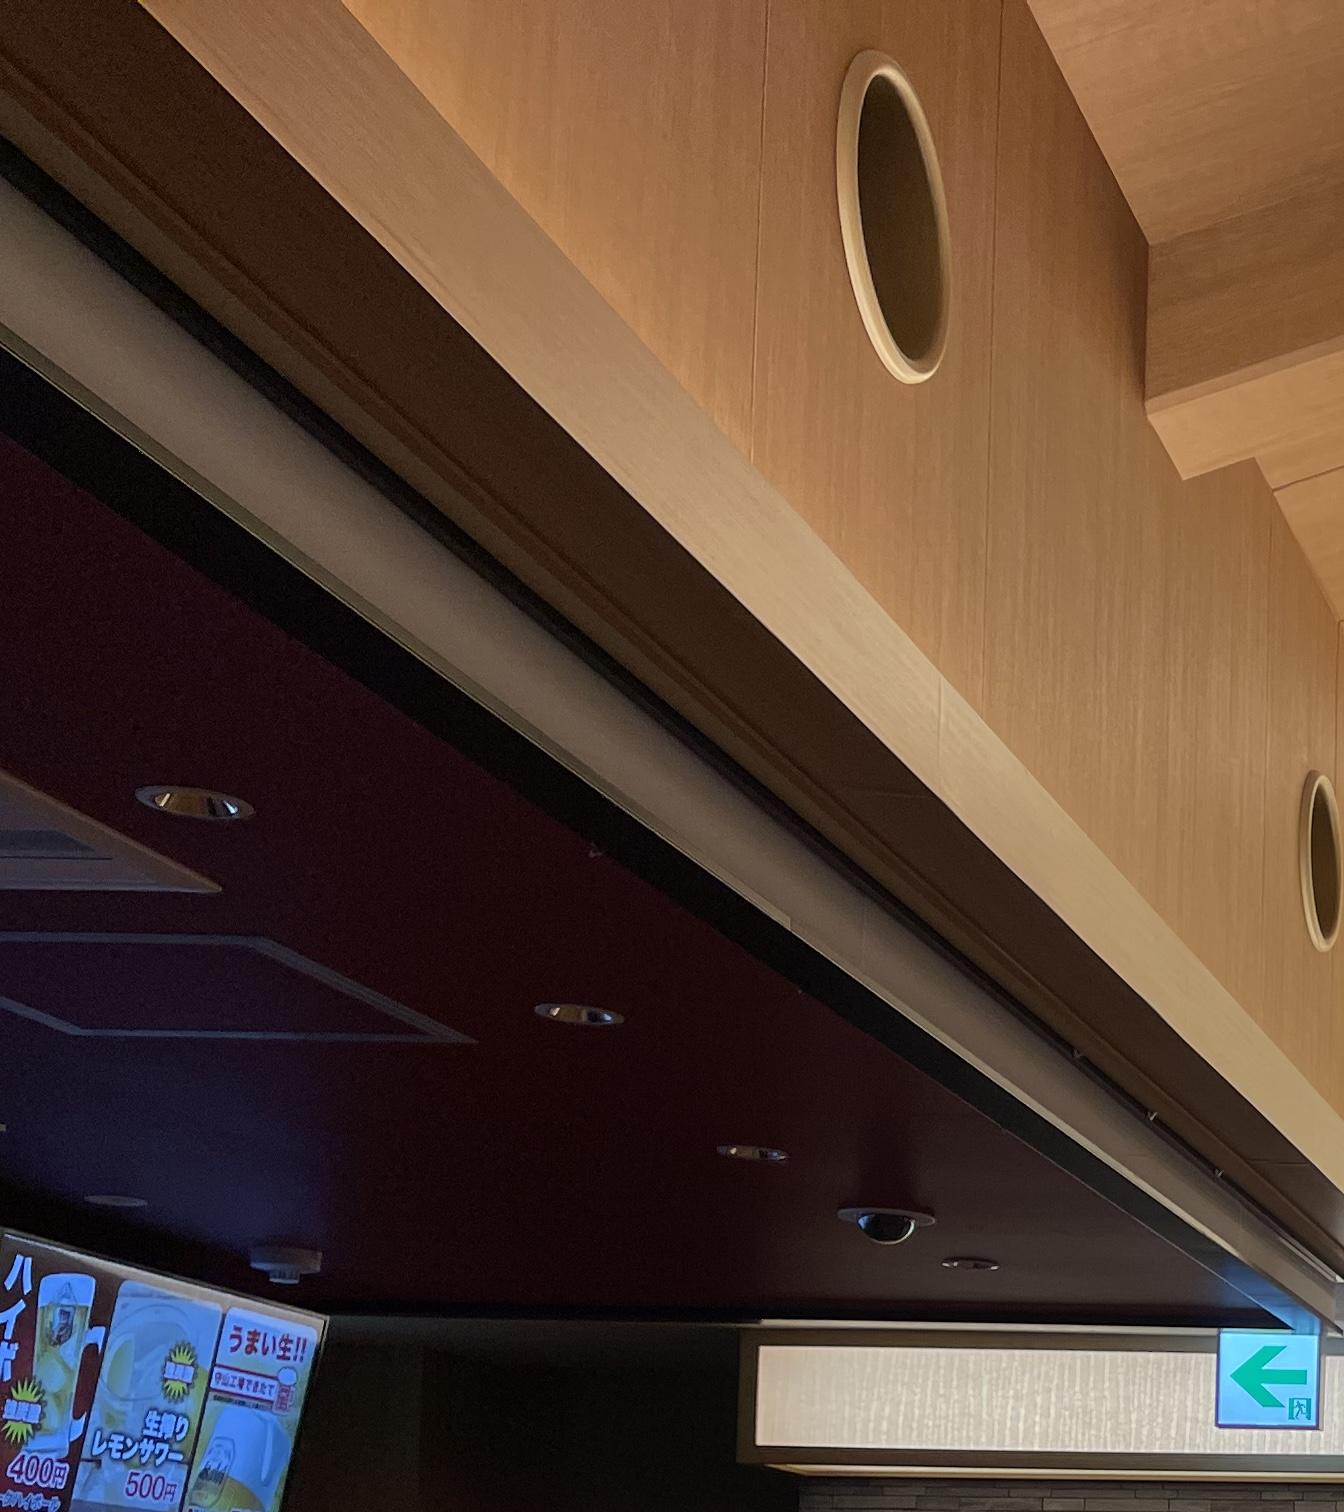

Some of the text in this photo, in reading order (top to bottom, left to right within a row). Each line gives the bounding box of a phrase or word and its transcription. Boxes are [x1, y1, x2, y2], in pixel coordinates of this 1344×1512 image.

[92, 1429, 184, 1467] レモンサワー
[7, 1454, 69, 1489] 400円
[125, 1471, 177, 1502] 500円
